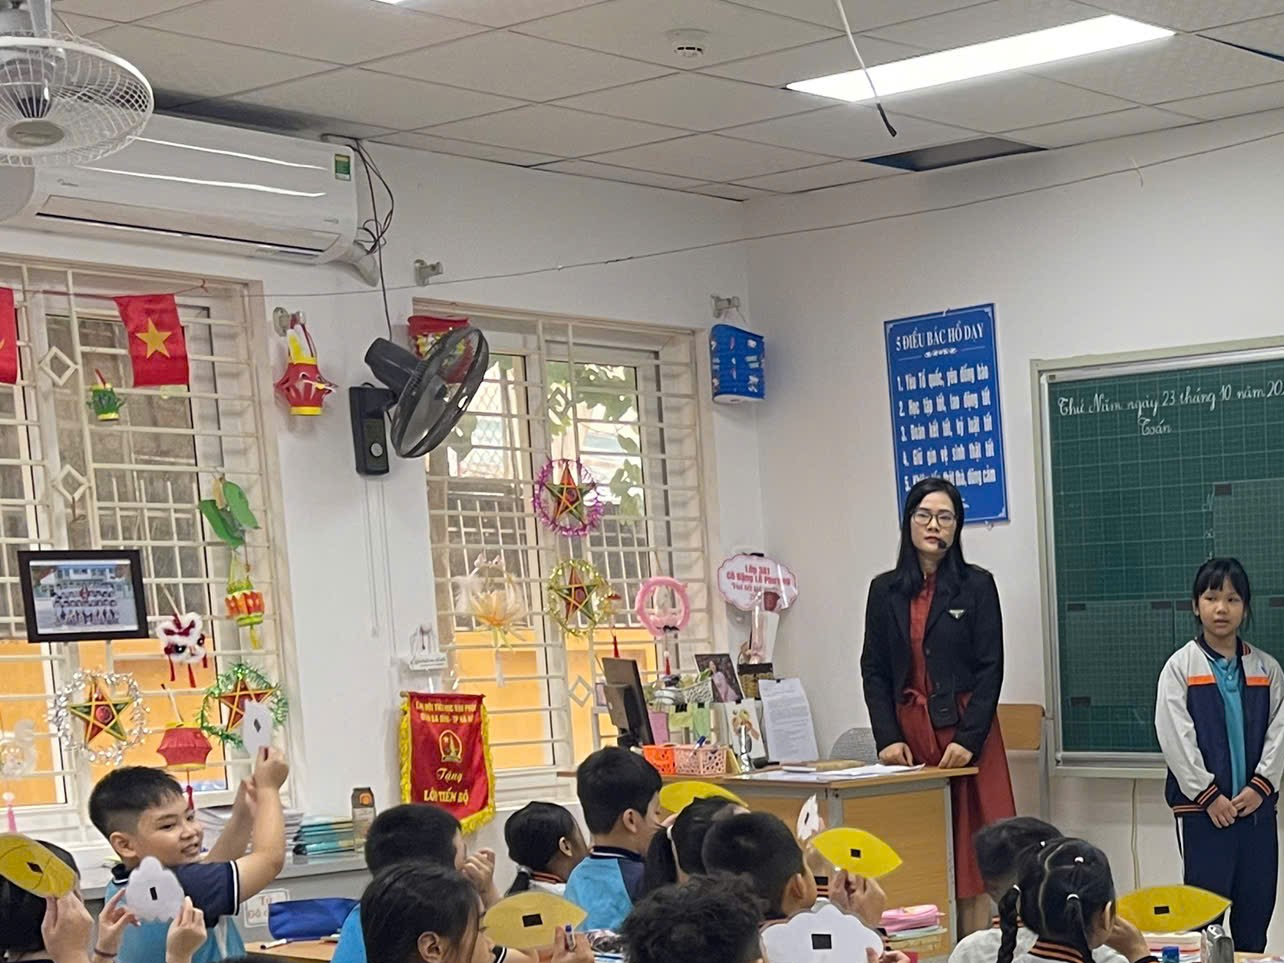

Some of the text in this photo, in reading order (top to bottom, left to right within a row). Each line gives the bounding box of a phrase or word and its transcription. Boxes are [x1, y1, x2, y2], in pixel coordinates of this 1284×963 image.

[896, 320, 984, 352] 5 ĐIỀU BÁC HỒ DẠY
[1127, 394, 1159, 418] ngày
[1162, 389, 1175, 407] 23
[1180, 385, 1216, 411] tháng
[1219, 383, 1232, 401] 10
[1236, 385, 1266, 399] năm
[1137, 417, 1172, 436] Toán
[436, 767, 464, 783] Tặng
